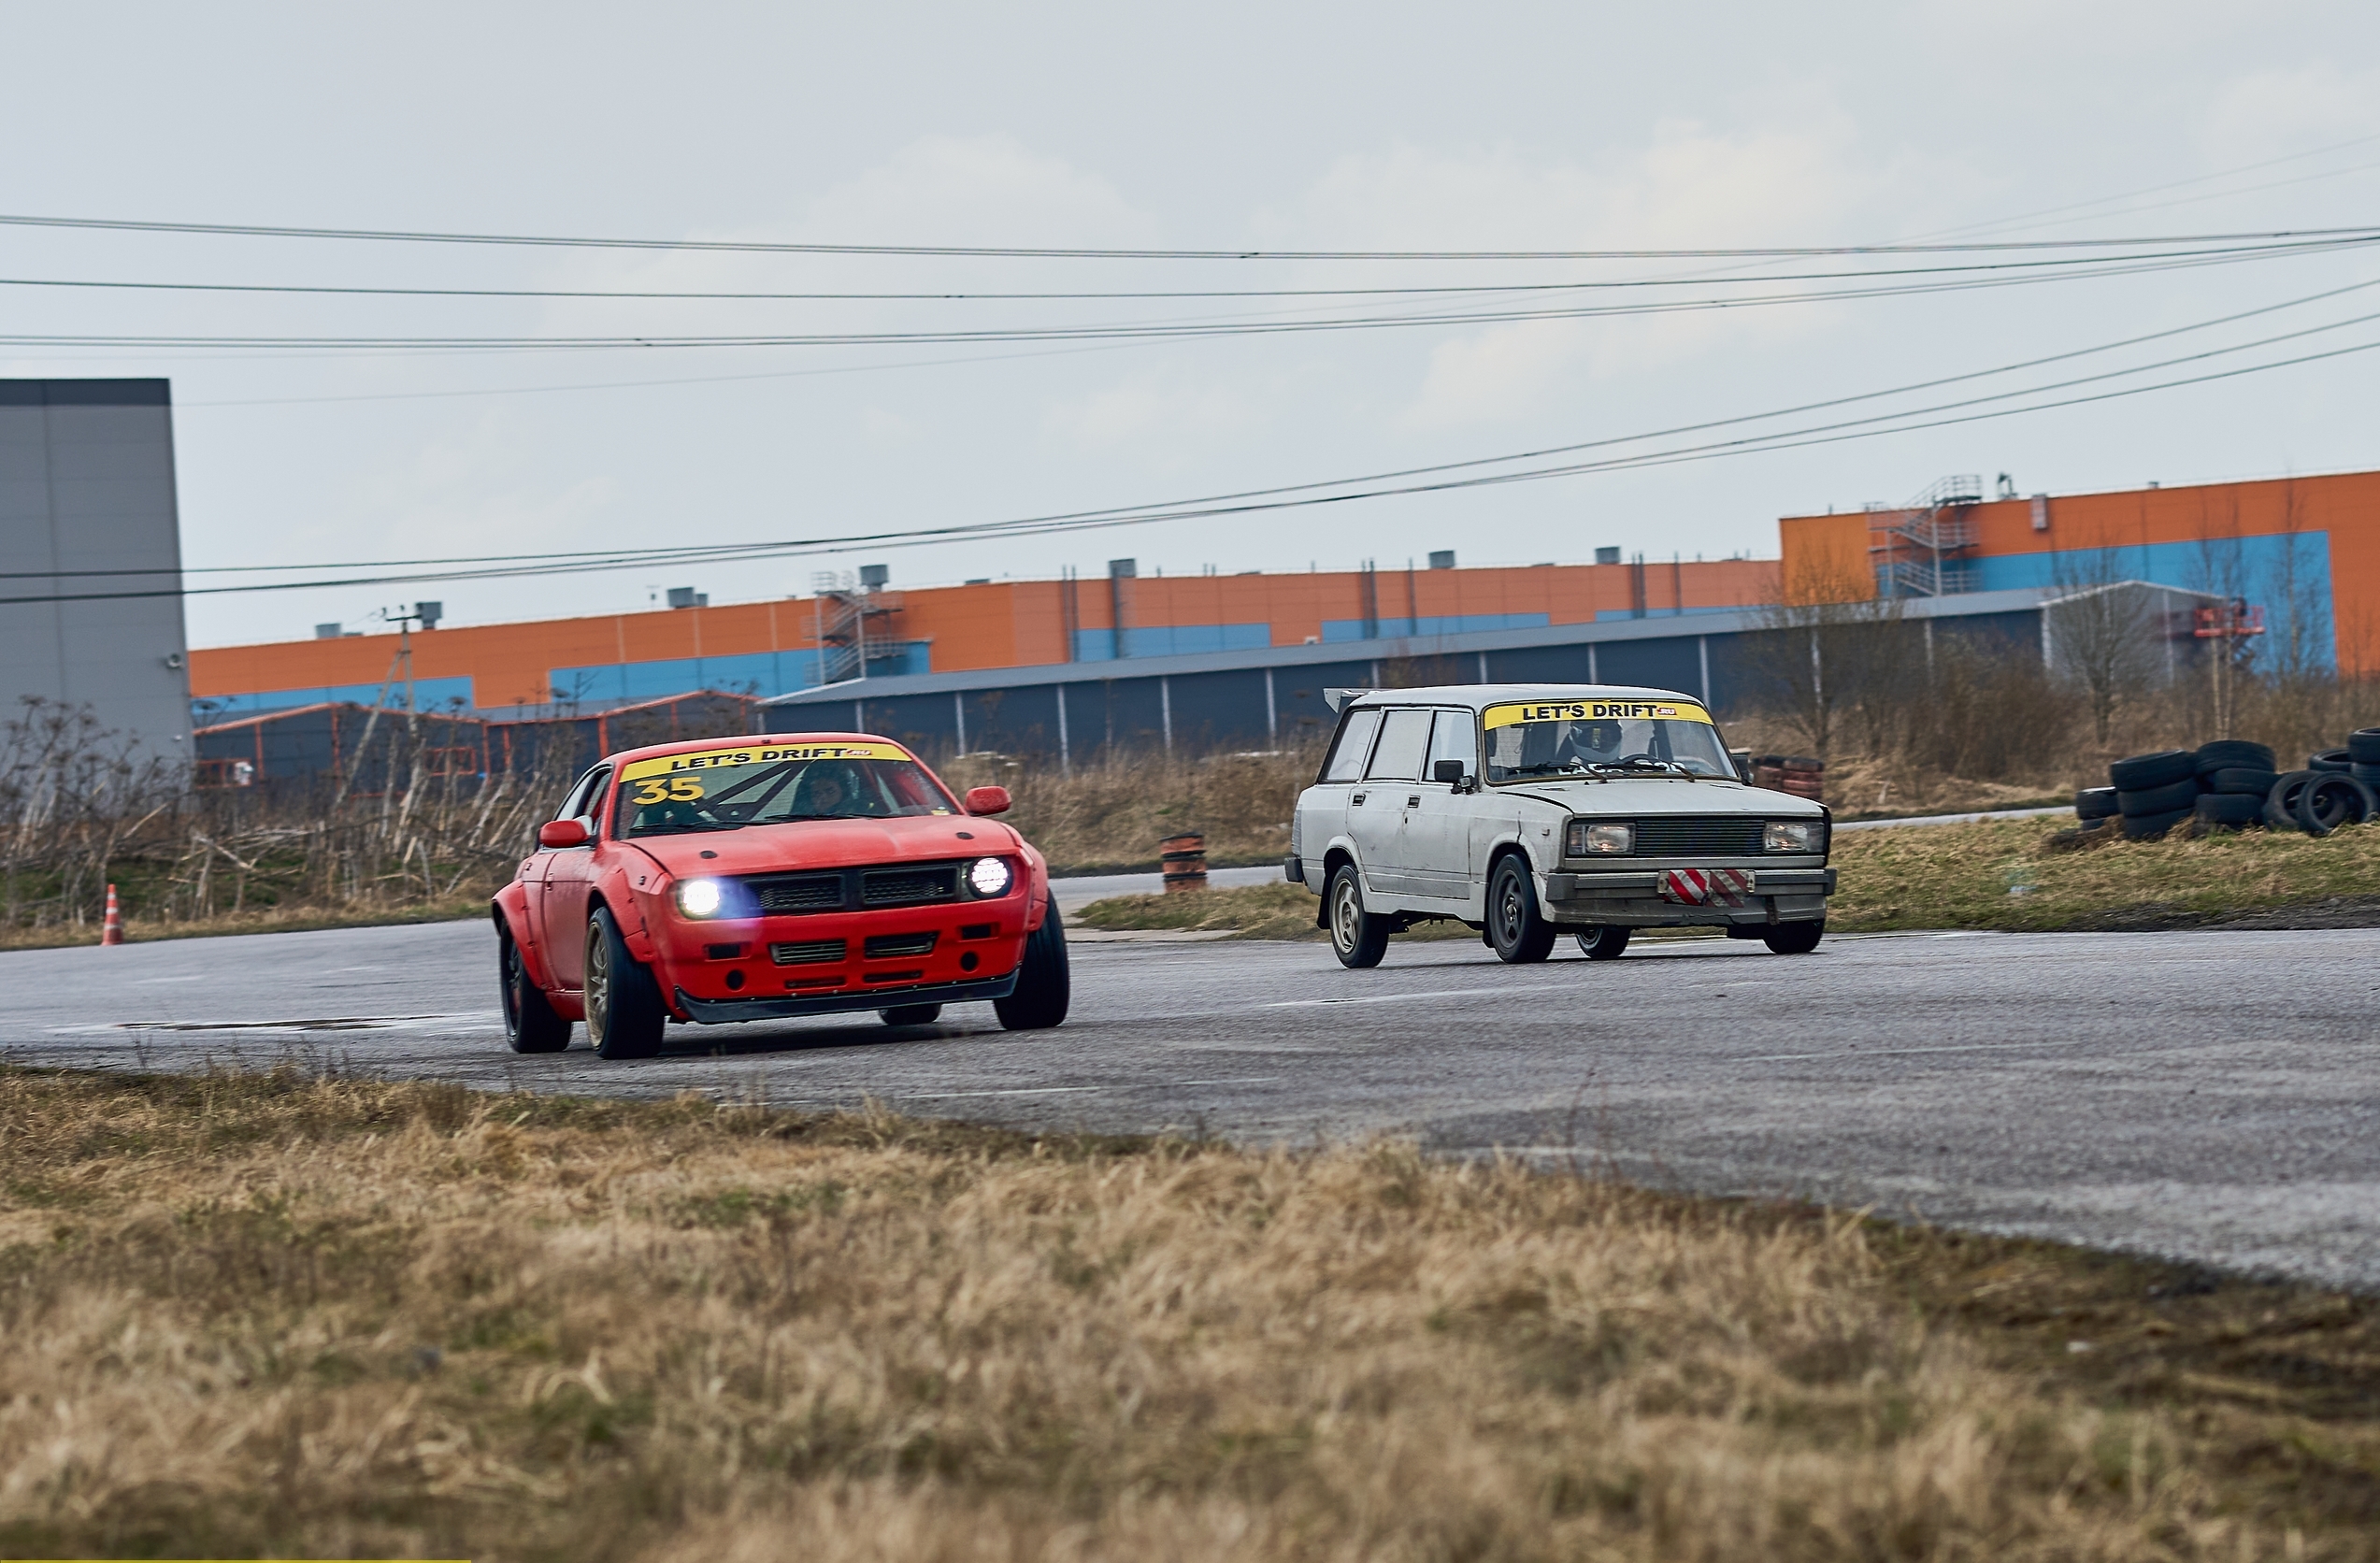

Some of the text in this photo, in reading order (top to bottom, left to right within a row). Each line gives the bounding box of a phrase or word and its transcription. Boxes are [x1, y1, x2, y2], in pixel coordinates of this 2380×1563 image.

[1523, 704, 1584, 721] LET'S
[671, 750, 751, 771] LET'S
[632, 776, 705, 805] 35
